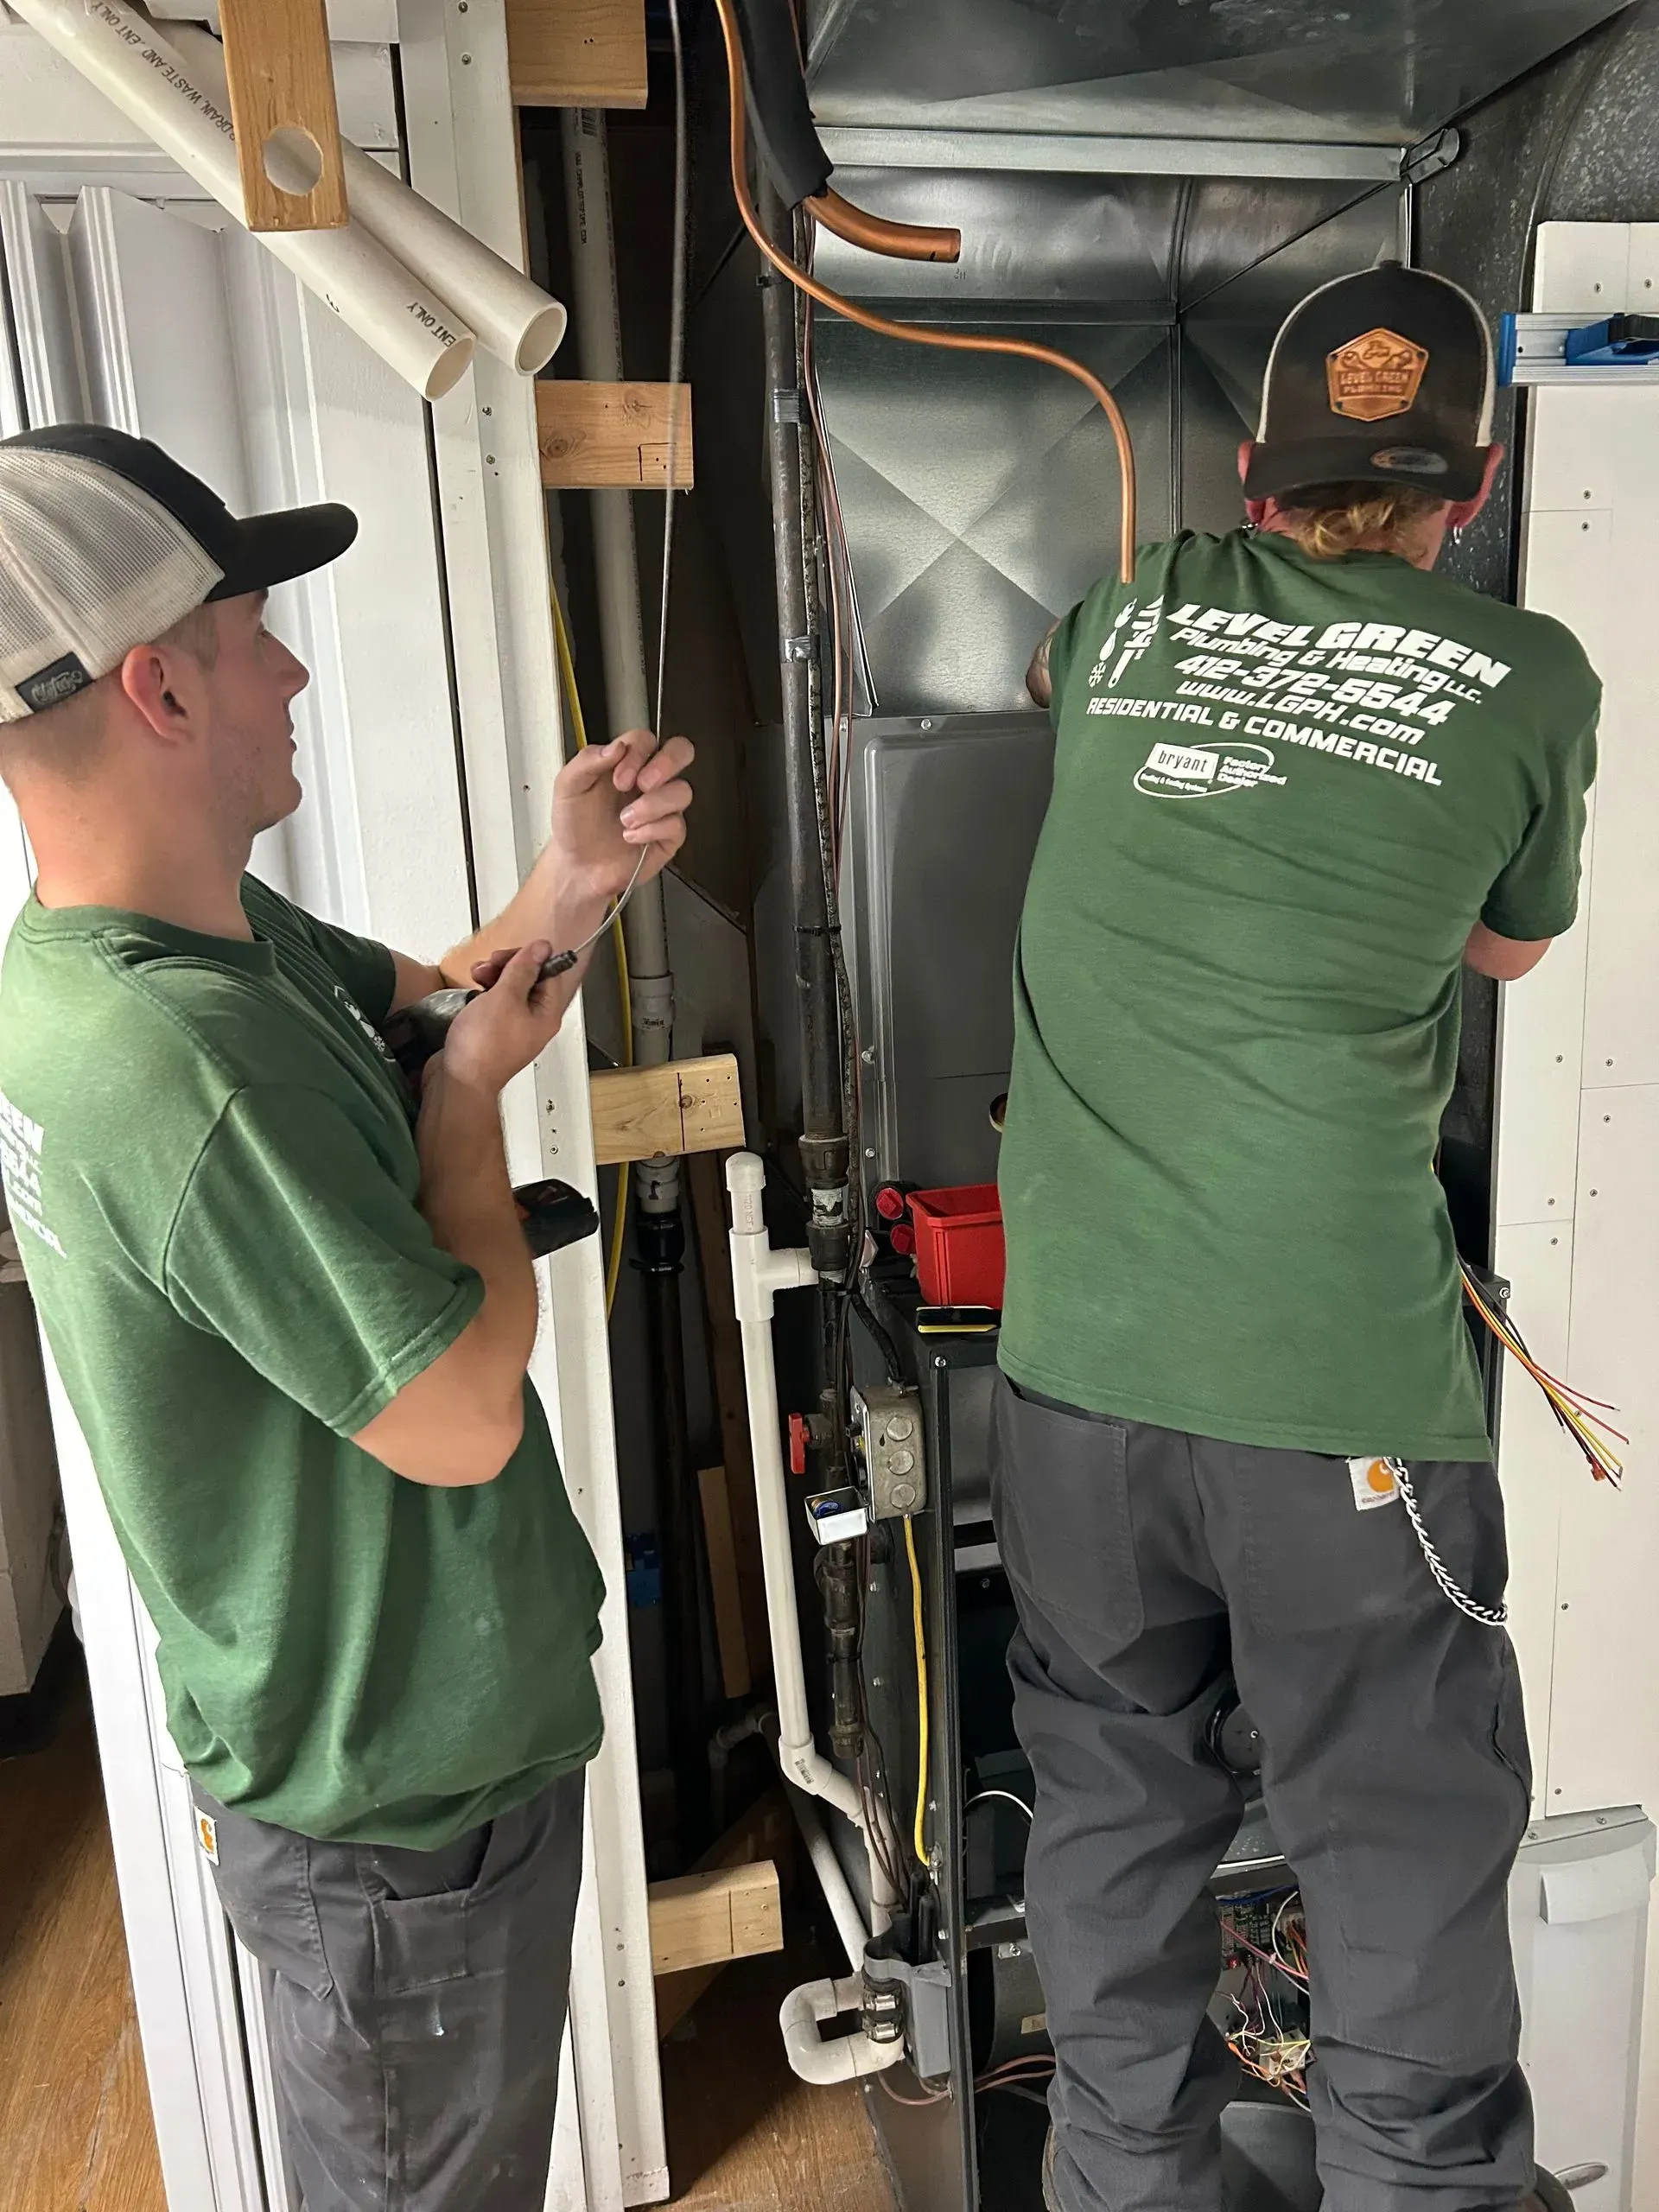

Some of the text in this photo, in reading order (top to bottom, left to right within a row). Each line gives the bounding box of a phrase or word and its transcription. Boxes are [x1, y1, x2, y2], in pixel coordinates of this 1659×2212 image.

[91, 2, 121, 26] ONLY
[115, 25, 146, 45] ENT
[141, 48, 168, 68] AND
[161, 67, 203, 105] WASTE
[406, 302, 457, 347] ENT ONLY
[1166, 603, 1512, 688] LEVEL GREEN
[1169, 626, 1300, 668] Plumbing
[1297, 650, 1327, 666] &
[1325, 650, 1451, 693] Heating
[1173, 654, 1457, 726] 412-372-5544
[1175, 680, 1426, 746] www.LGPH.com
[1086, 696, 1442, 786] RESIDENTIAL & COMMERCIAL
[1158, 750, 1209, 773] bryant
